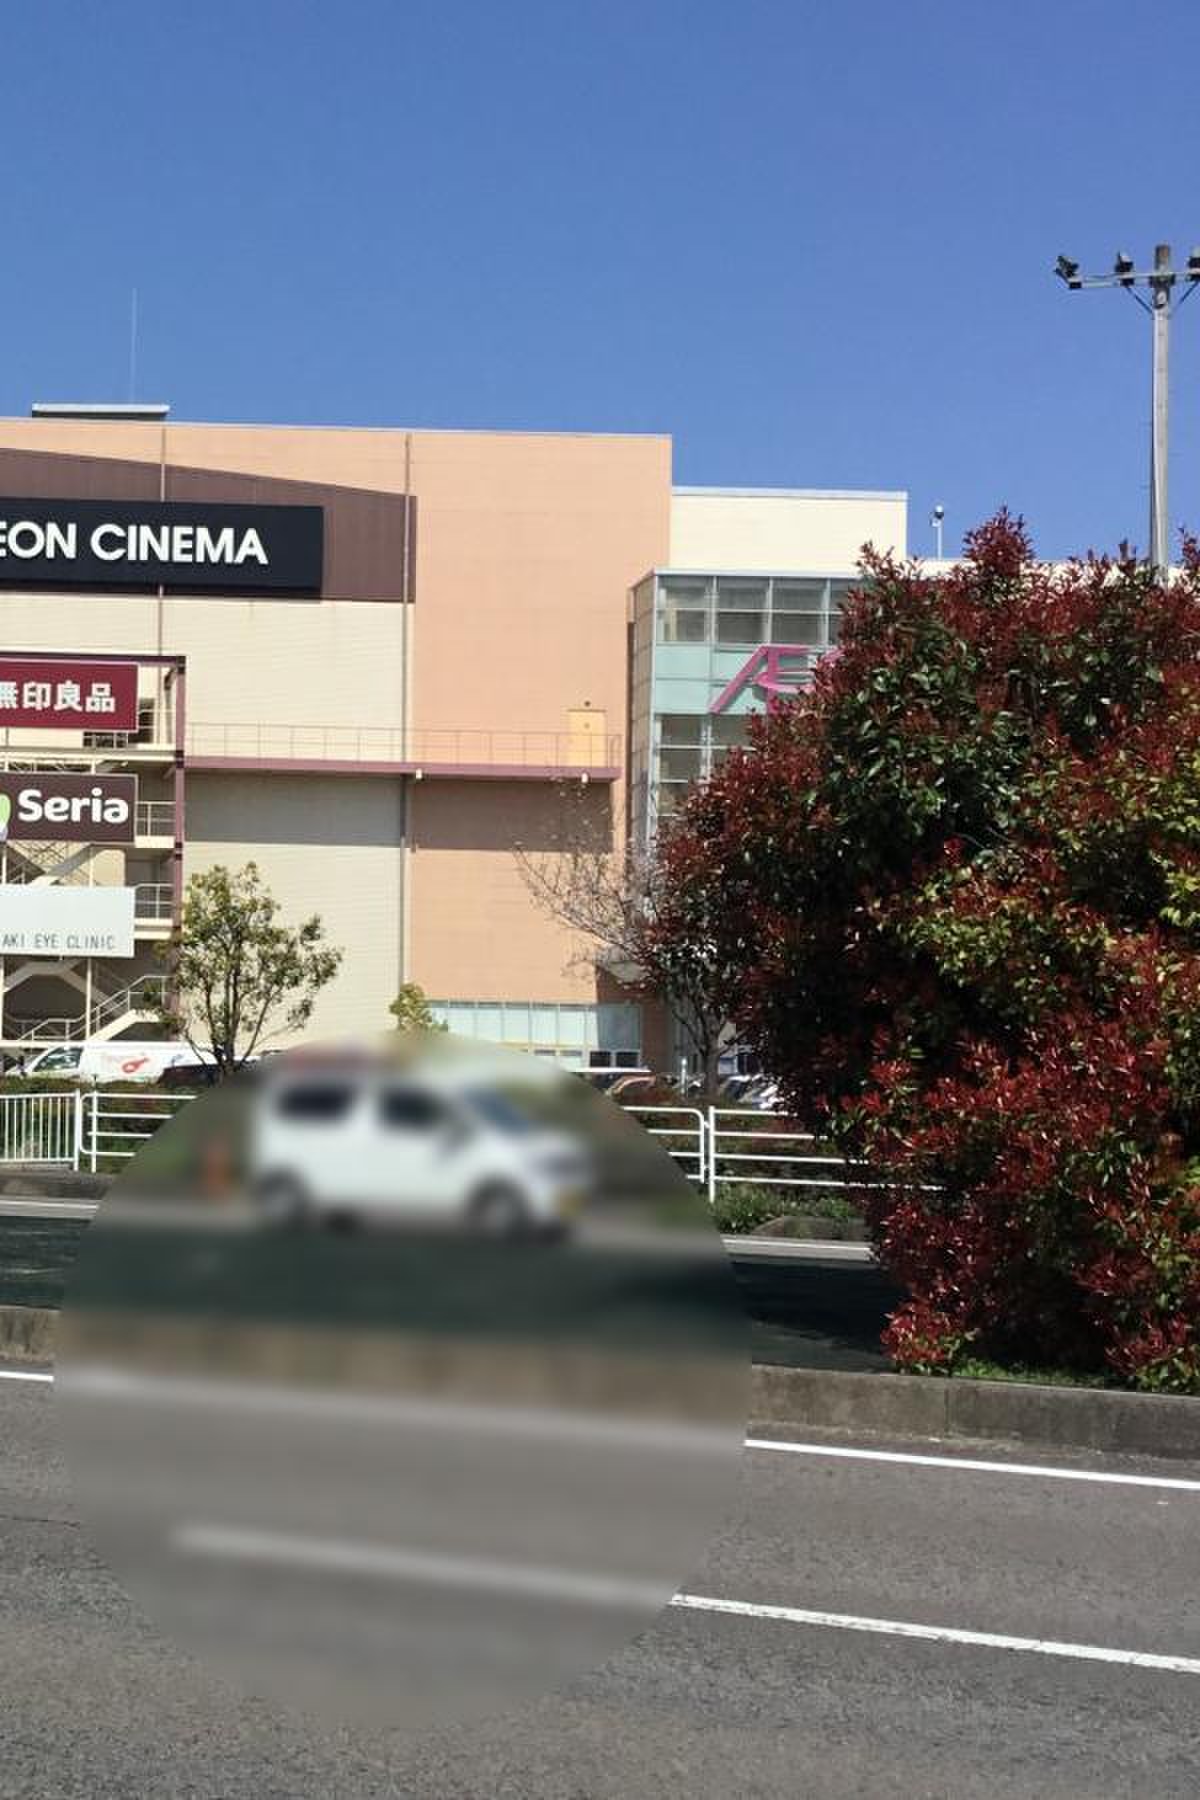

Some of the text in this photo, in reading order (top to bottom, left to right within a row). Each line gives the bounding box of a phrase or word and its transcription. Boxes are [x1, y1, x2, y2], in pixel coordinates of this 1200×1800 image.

[91, 524, 269, 565] CINEMA
[18, 787, 129, 824] Seria
[34, 934, 59, 949] EYE
[67, 935, 115, 950] CLINIC
